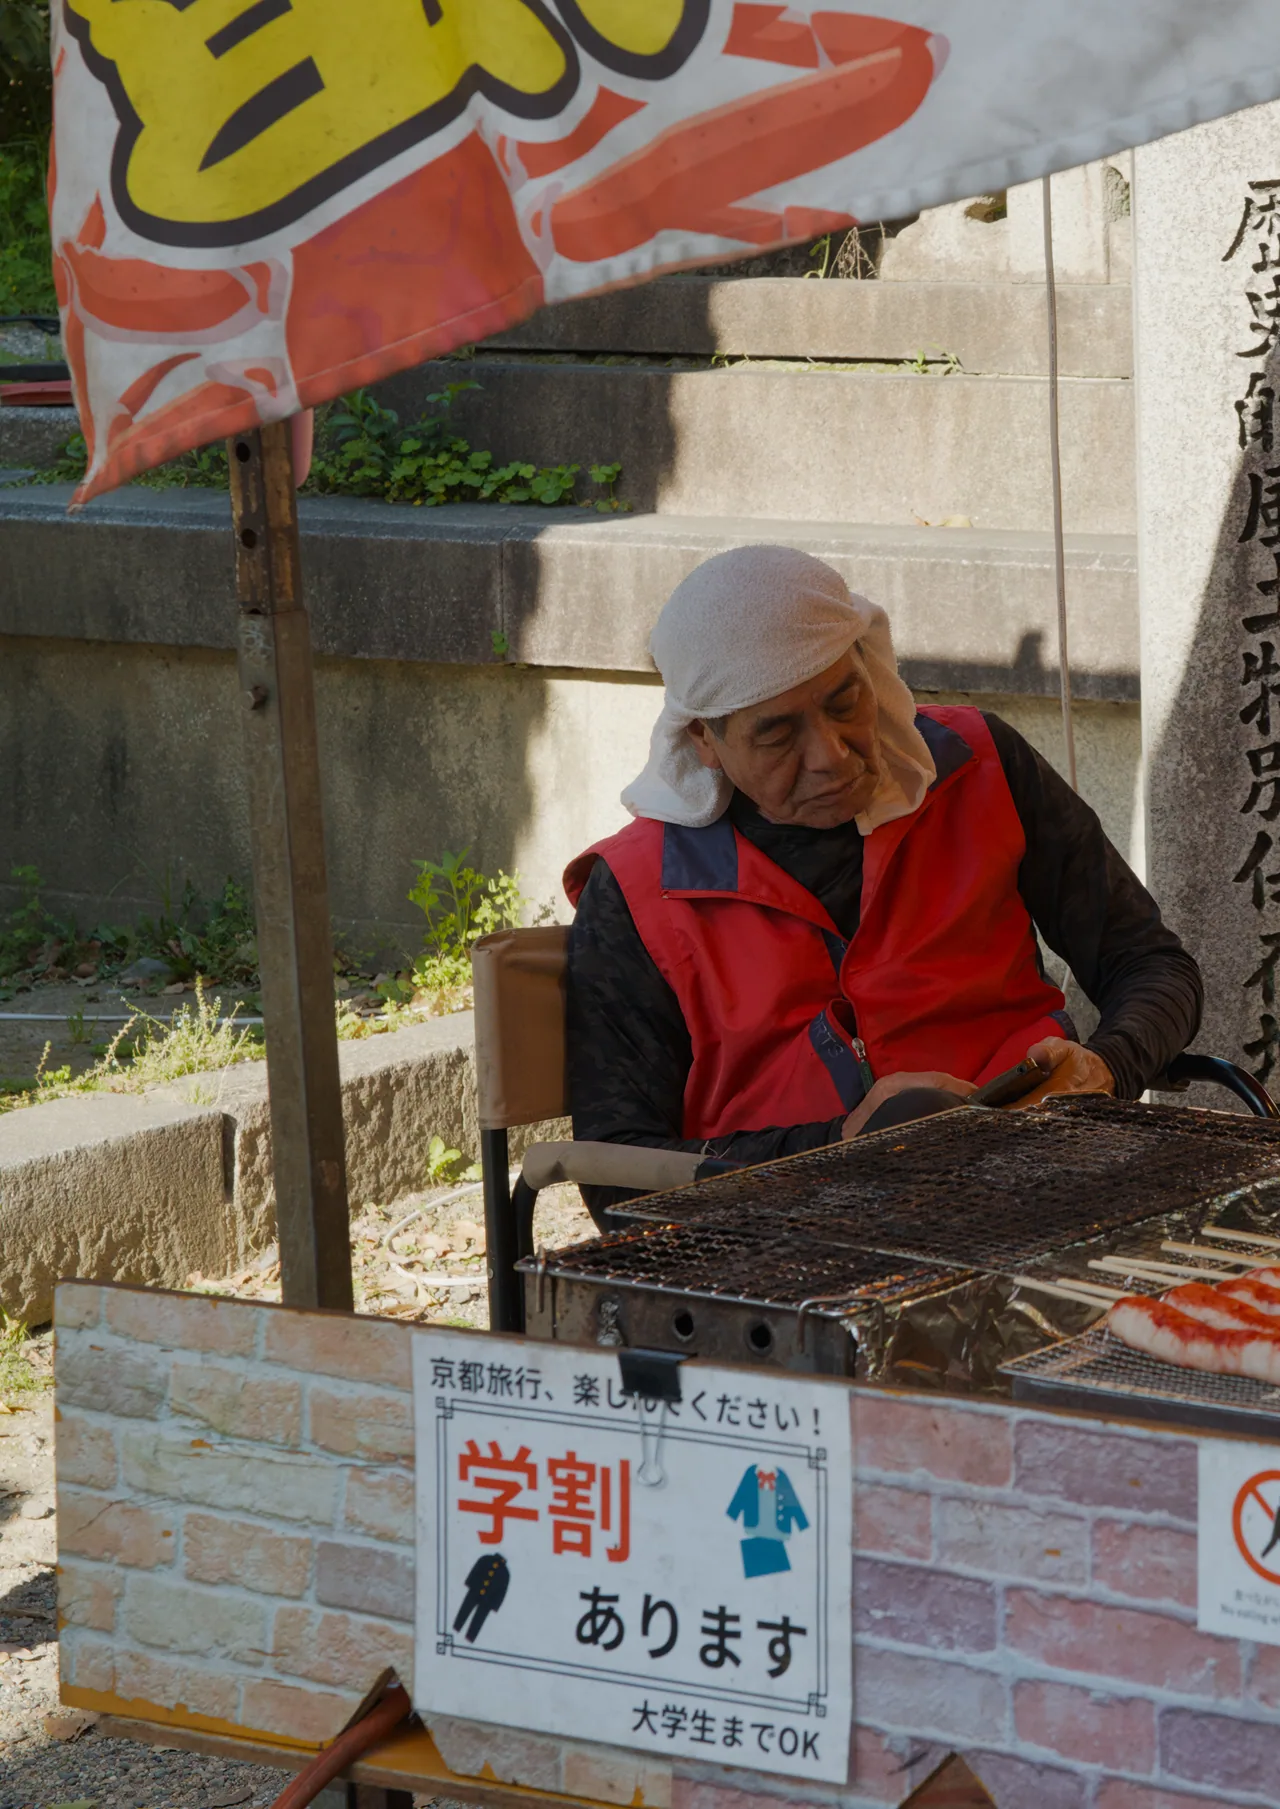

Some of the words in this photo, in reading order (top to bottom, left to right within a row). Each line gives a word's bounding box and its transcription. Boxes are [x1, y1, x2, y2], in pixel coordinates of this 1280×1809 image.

[457, 1438, 631, 1564] 学割
[575, 1585, 807, 1679] あります
[631, 1699, 821, 1762] 大学生までOK
